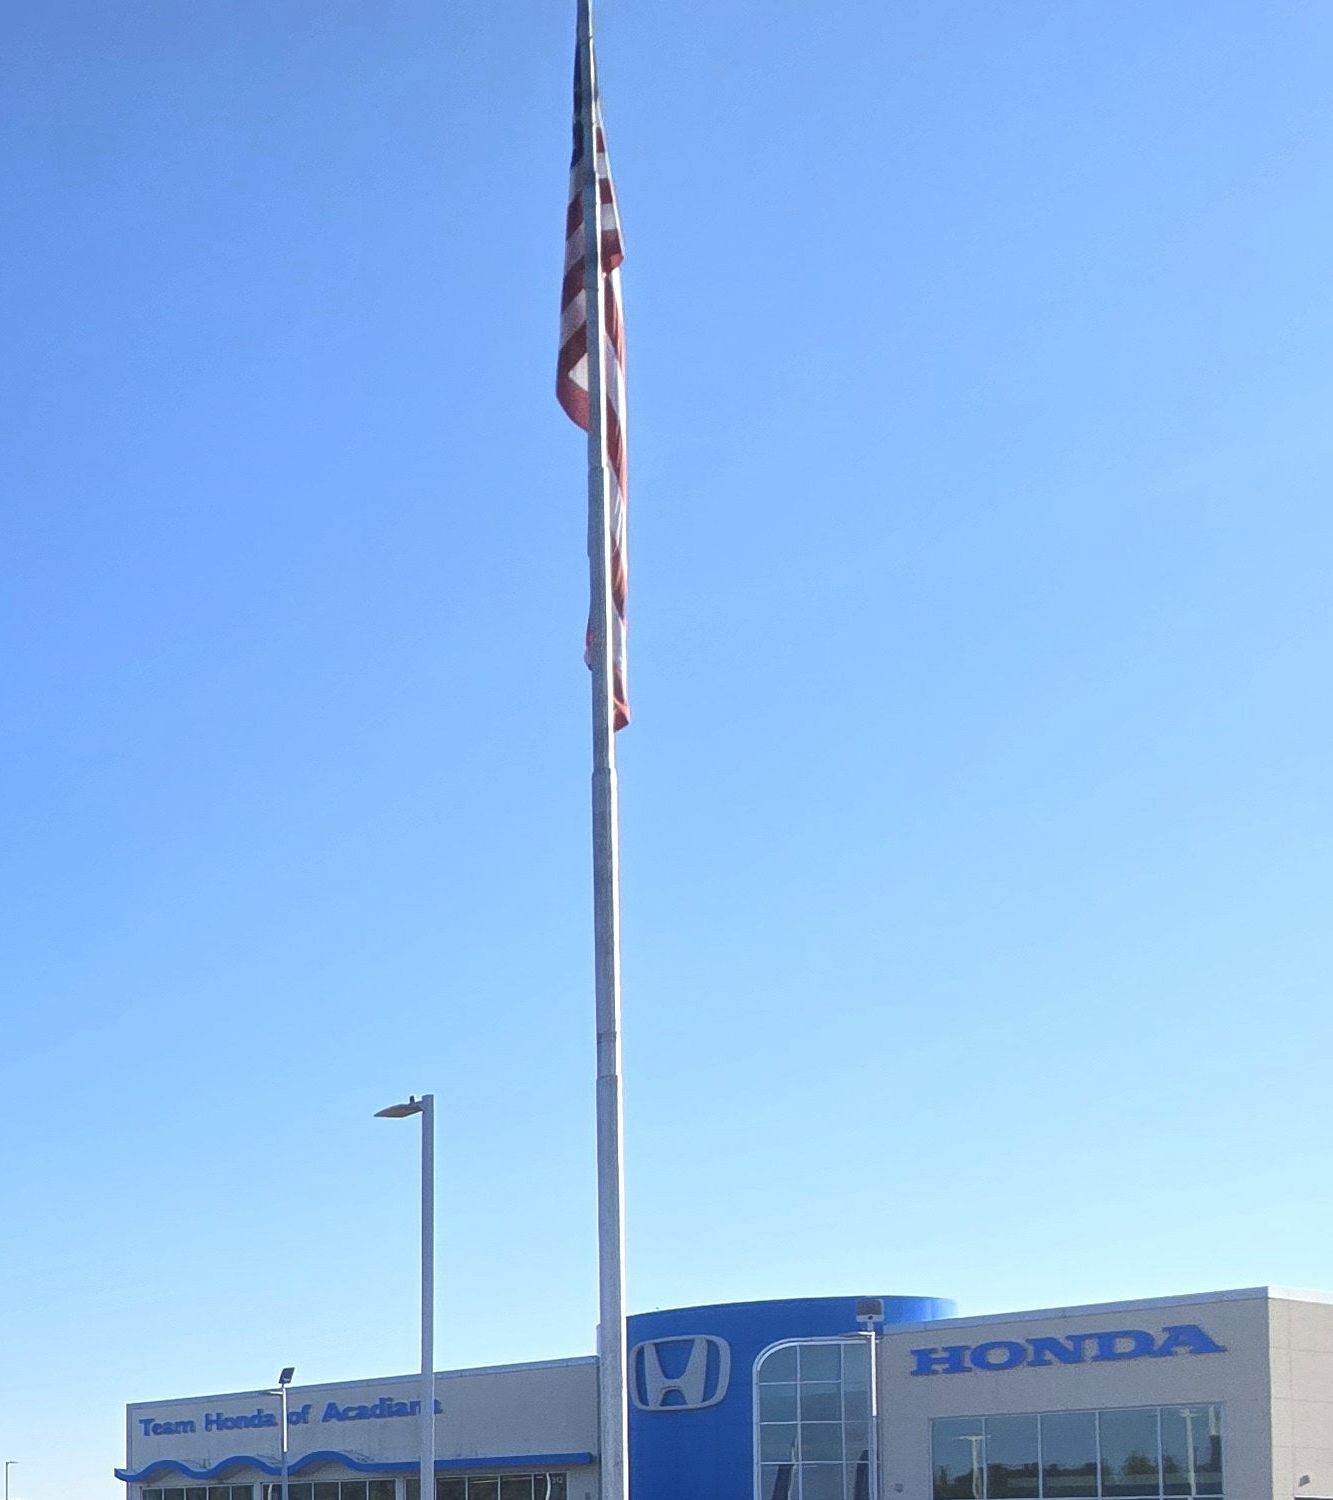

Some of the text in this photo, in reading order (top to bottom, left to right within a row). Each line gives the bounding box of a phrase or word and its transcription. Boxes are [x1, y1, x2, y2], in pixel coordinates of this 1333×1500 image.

[910, 1324, 1227, 1377] HONDA
[139, 1418, 197, 1437] Team
[204, 1408, 279, 1432] Honda
[287, 1404, 313, 1426] of
